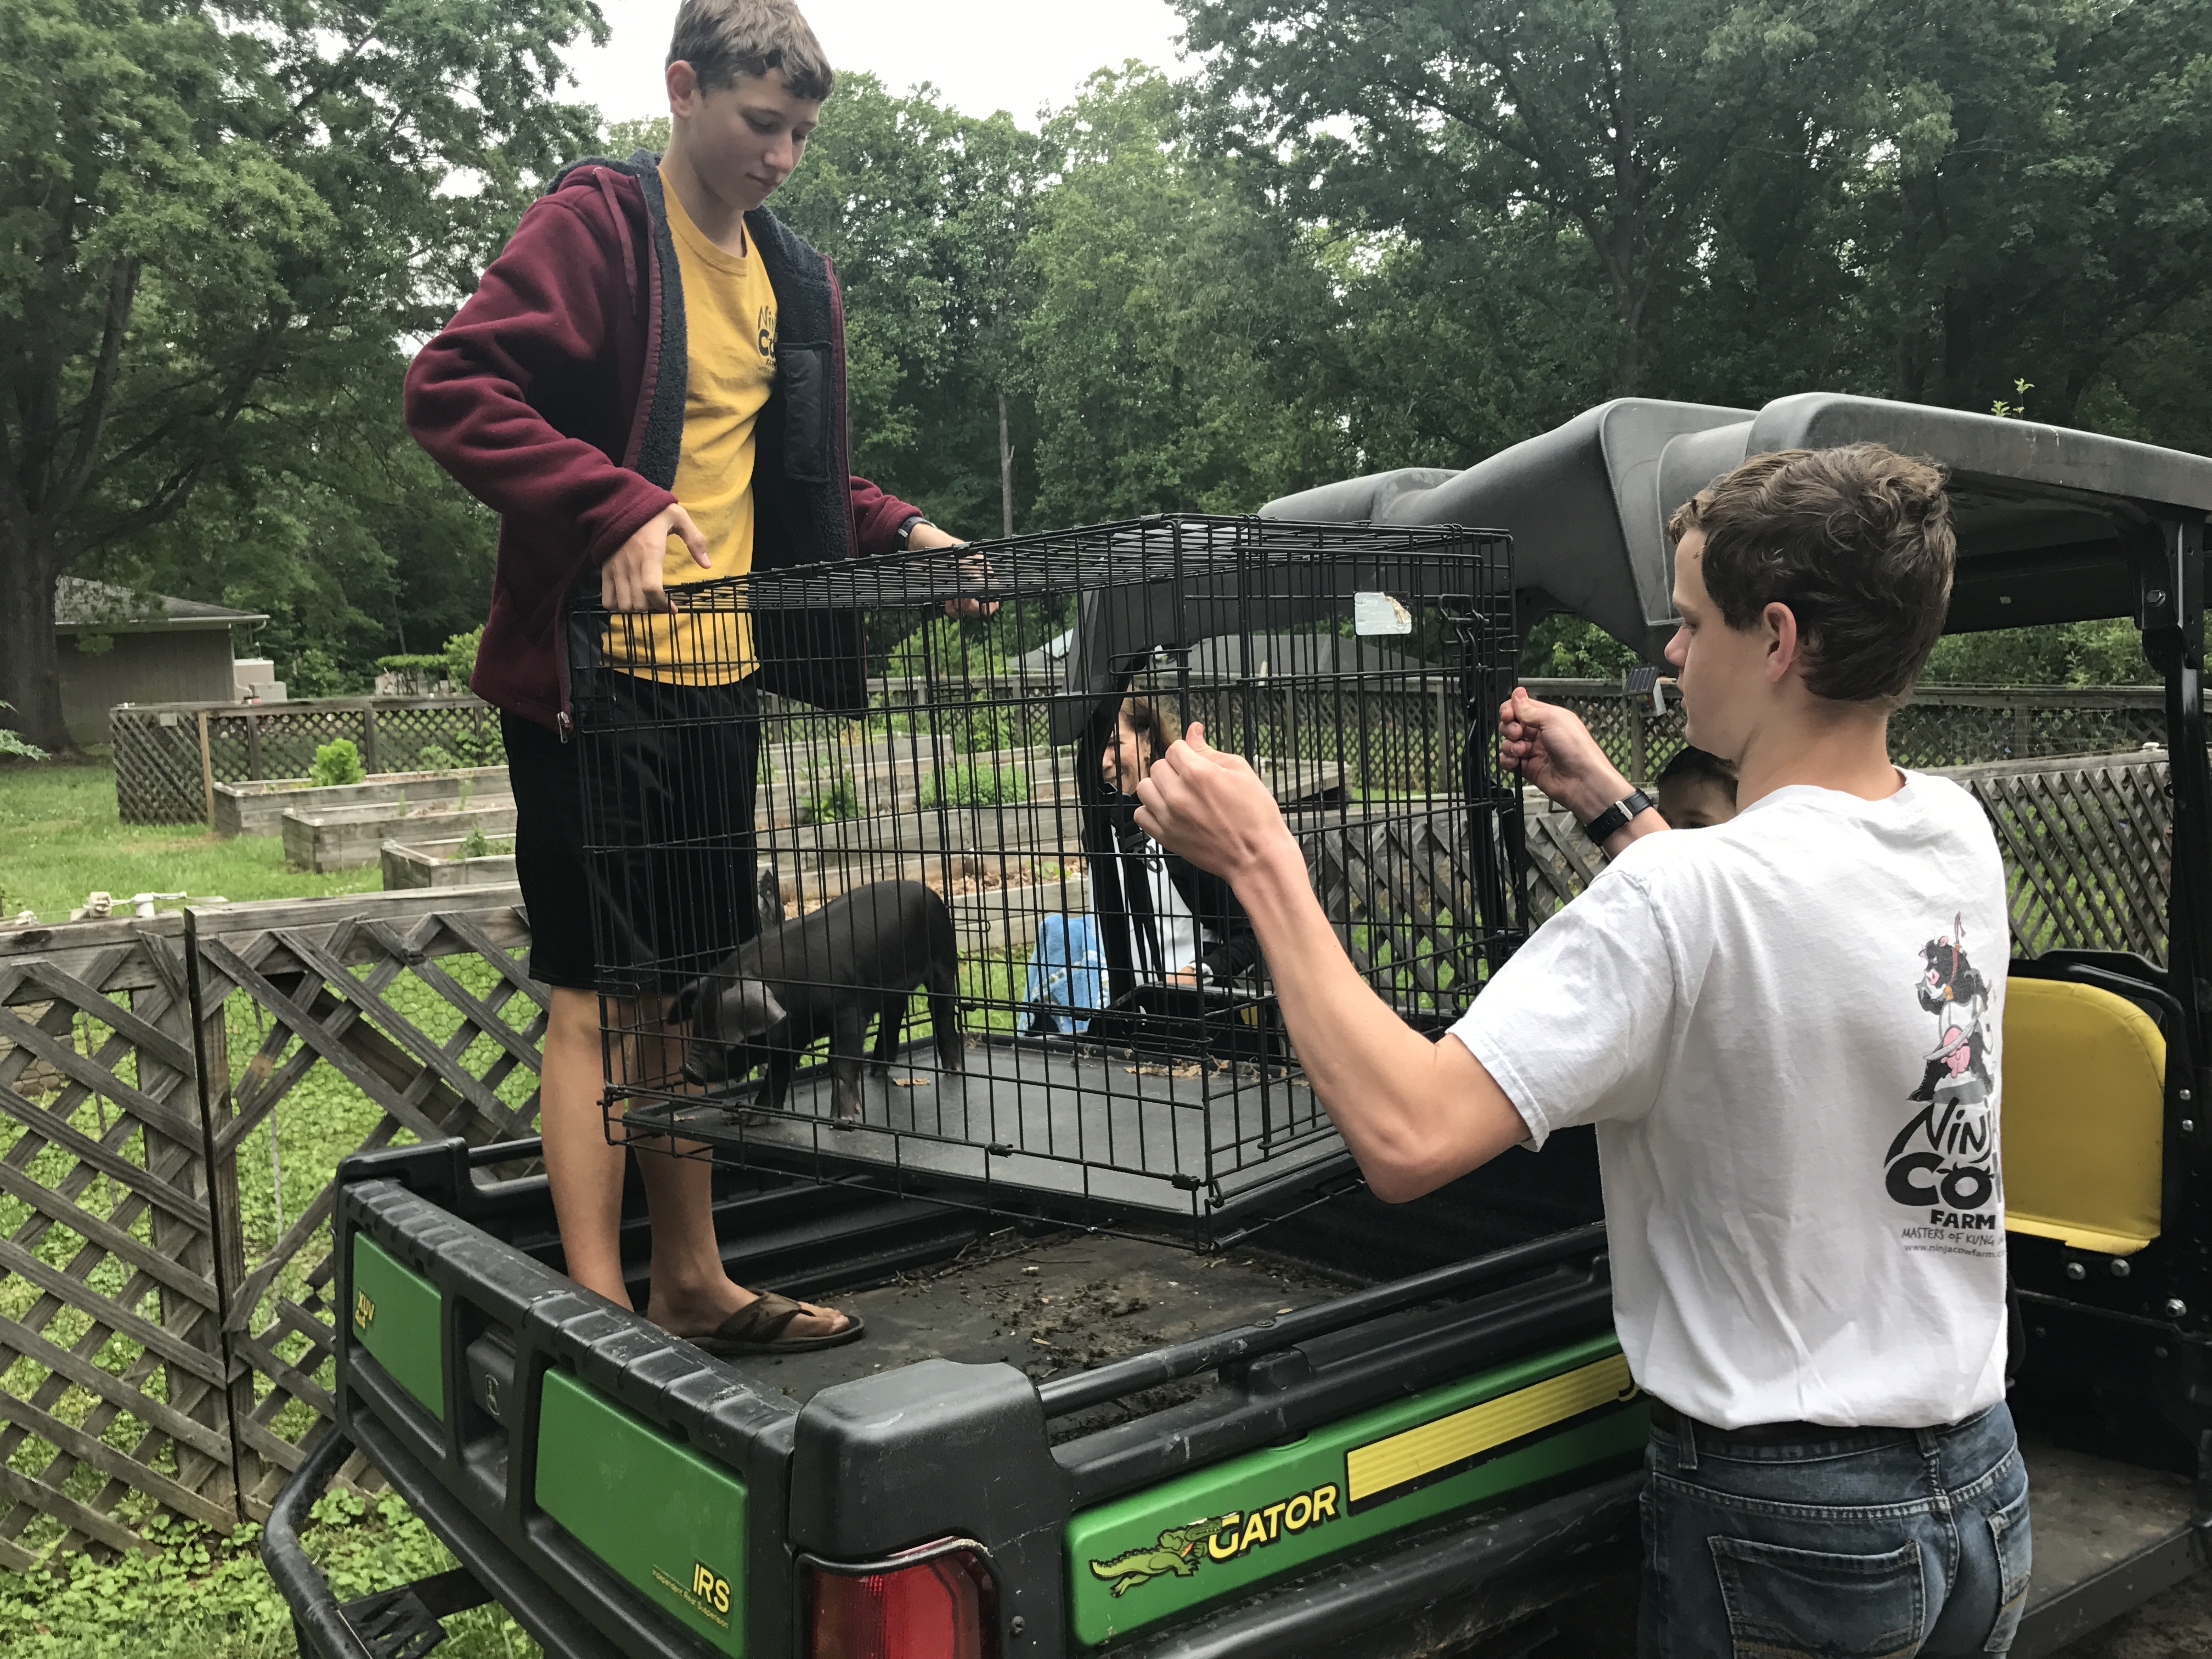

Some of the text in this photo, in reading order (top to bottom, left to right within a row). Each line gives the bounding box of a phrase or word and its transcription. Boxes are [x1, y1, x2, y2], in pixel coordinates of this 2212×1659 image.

[1901, 1228, 1945, 1241] MASTERS
[1966, 1234, 1995, 1247] KUNG
[1930, 1209, 1996, 1230] FARM
[1207, 1484, 1338, 1560] GATOR
[692, 1562, 731, 1613] IRS
